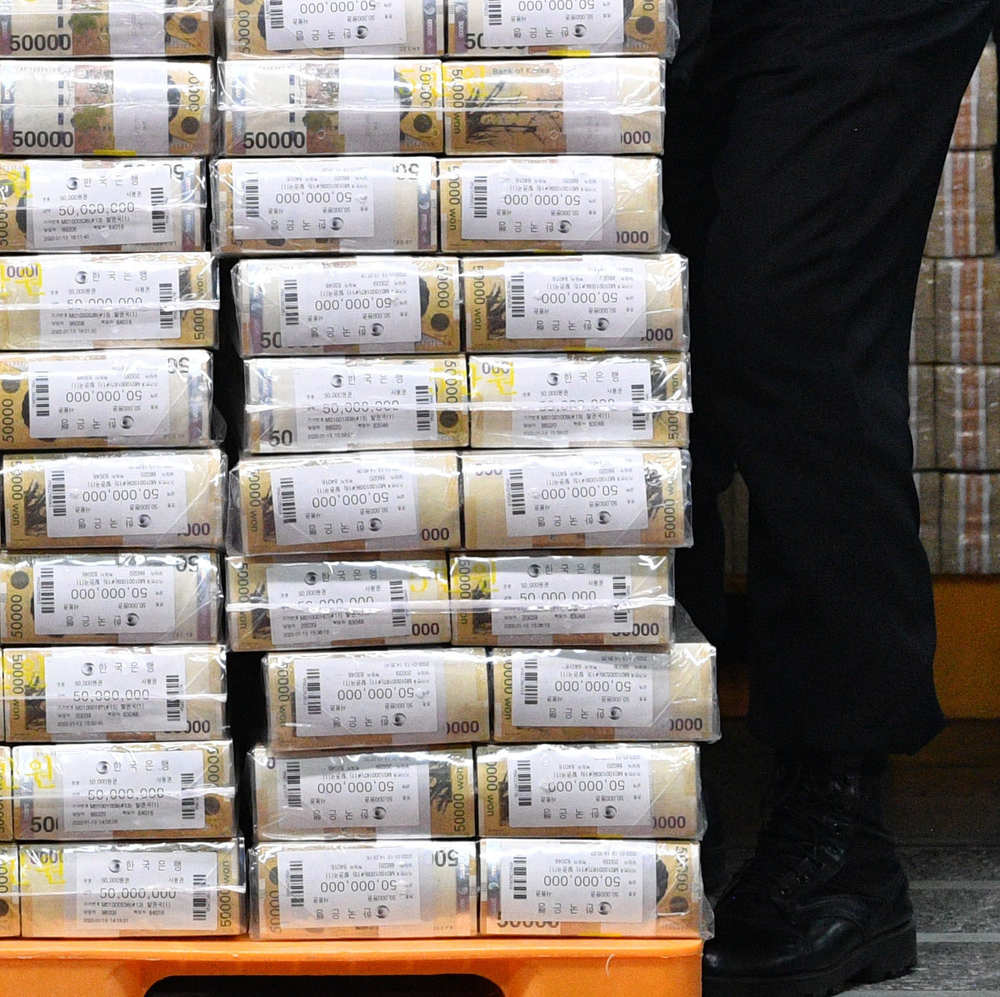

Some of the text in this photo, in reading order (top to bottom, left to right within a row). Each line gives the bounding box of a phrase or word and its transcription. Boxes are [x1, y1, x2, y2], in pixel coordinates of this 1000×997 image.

[300, 1, 376, 14] 50,000,000
[519, 0, 595, 11] 50,000,000
[239, 9, 251, 54] 50000
[10, 34, 71, 52] 50000
[453, 113, 461, 135] won
[12, 130, 73, 148] 50000
[244, 132, 305, 149] 50000
[276, 192, 352, 204] 50,000,000
[505, 194, 581, 206] 50,000,000
[449, 209, 457, 231] won
[315, 299, 392, 311] 50,000,000
[542, 293, 618, 304] 50,000,000
[474, 308, 482, 330] won
[66, 390, 142, 402] 50,000,000
[3, 398, 14, 441] 50000
[83, 488, 158, 501] 50,000,000
[312, 490, 389, 508] 50,000,000
[542, 486, 618, 501] 50,000,000
[13, 507, 21, 526] won
[664, 496, 677, 539] 50000
[71, 586, 148, 598] 50,000,000
[11, 595, 23, 638] 50000
[12, 654, 23, 696] 50000
[556, 681, 632, 692] 50,000,000
[338, 688, 415, 701] 50,000,000
[318, 782, 393, 794] 50,000,000
[548, 780, 625, 792] 50,000,000
[454, 794, 465, 834] 50000
[487, 797, 495, 818] won
[321, 880, 396, 892] 50,000,000
[544, 876, 620, 887] 50,000,000
